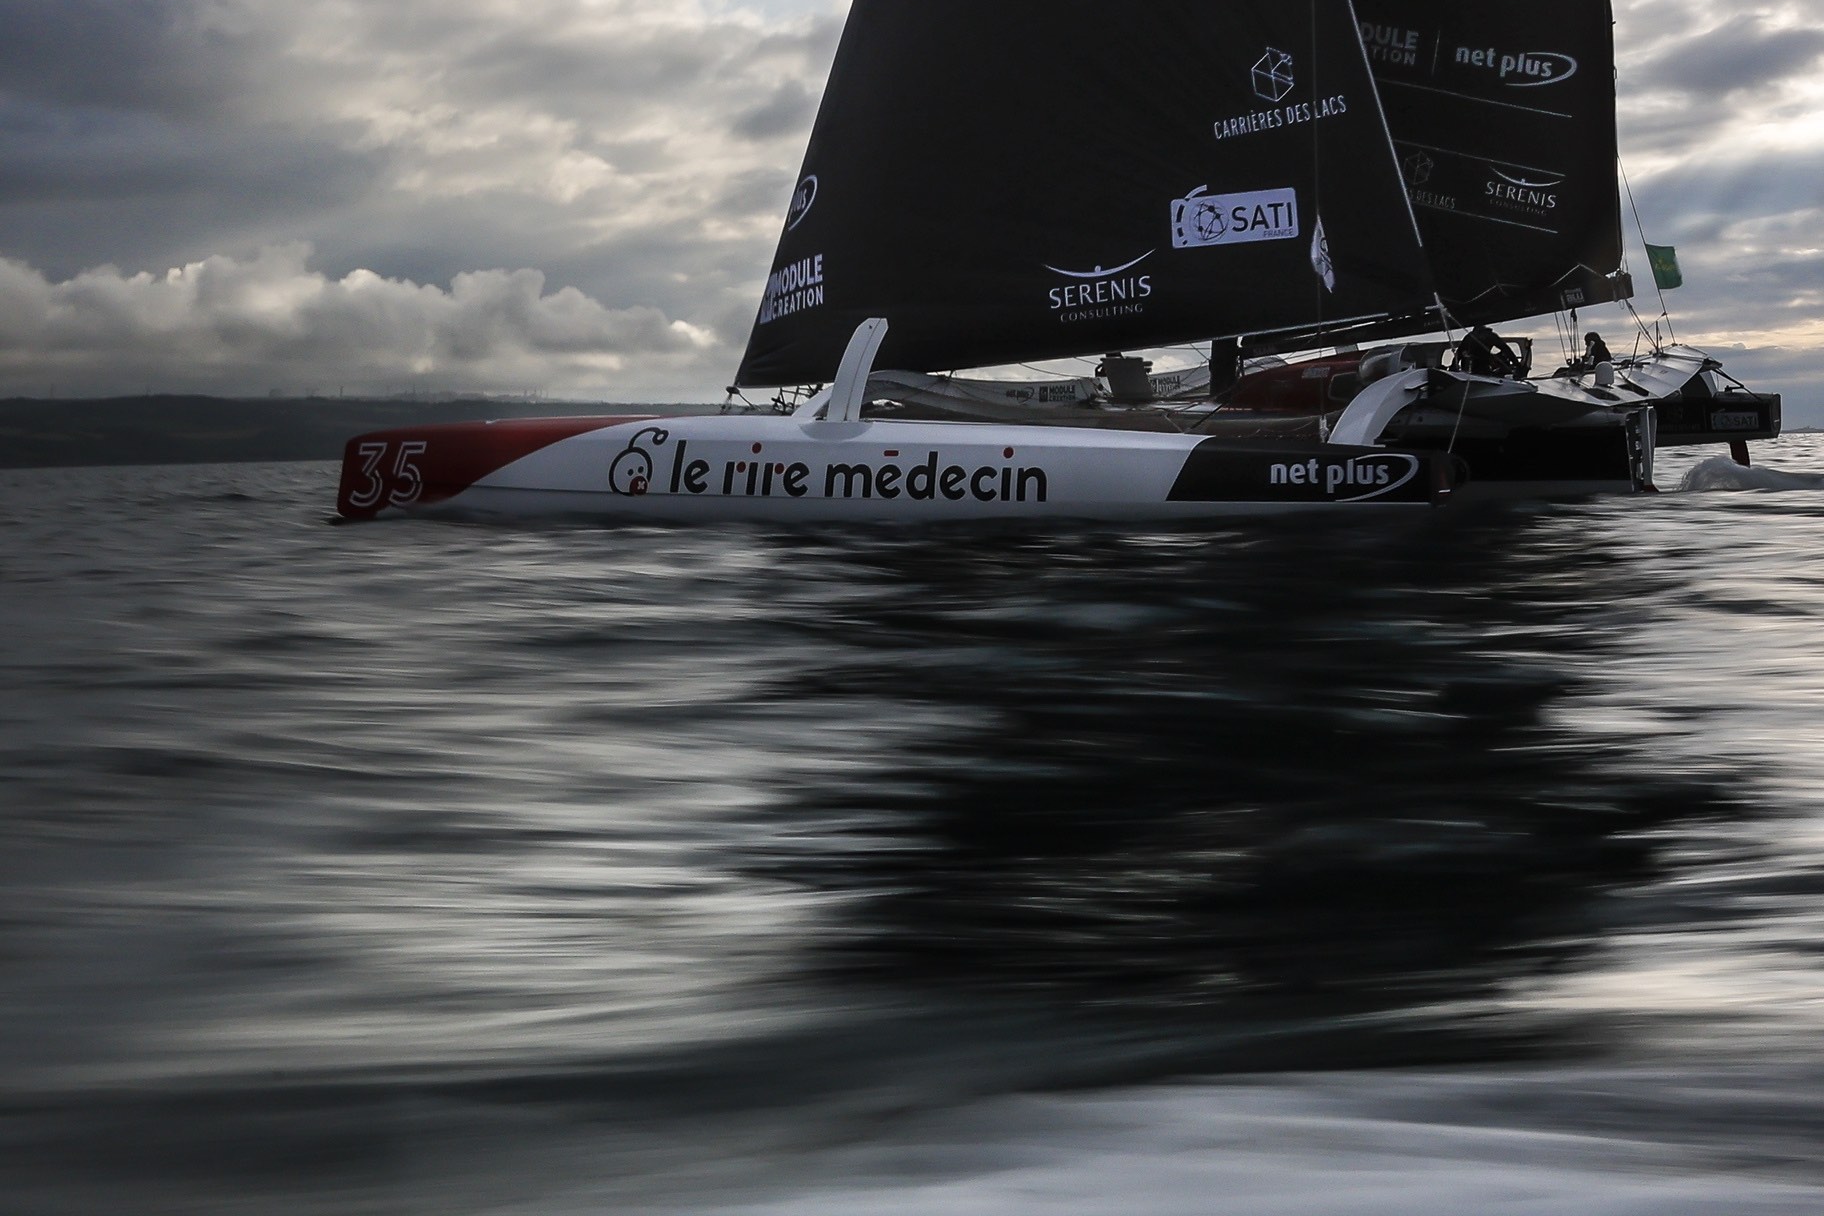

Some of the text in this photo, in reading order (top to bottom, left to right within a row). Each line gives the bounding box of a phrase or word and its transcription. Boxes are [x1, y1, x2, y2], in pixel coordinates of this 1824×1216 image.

[1455, 45, 1553, 79] net plus
[1213, 94, 1347, 140] CARRIÈRES DES LACS
[1485, 180, 1558, 209] SERENIS
[1231, 201, 1294, 233] SATI
[1262, 227, 1295, 238] FRANCE
[773, 253, 823, 297] MODULE
[1049, 274, 1153, 309] SERENIS
[772, 284, 824, 321] CREATION
[1060, 301, 1144, 324] CONSULTING
[1733, 414, 1758, 426] SATI
[348, 440, 429, 509] 35
[669, 439, 711, 495] le
[723, 442, 810, 497] rire
[1270, 457, 1390, 494] net plus
